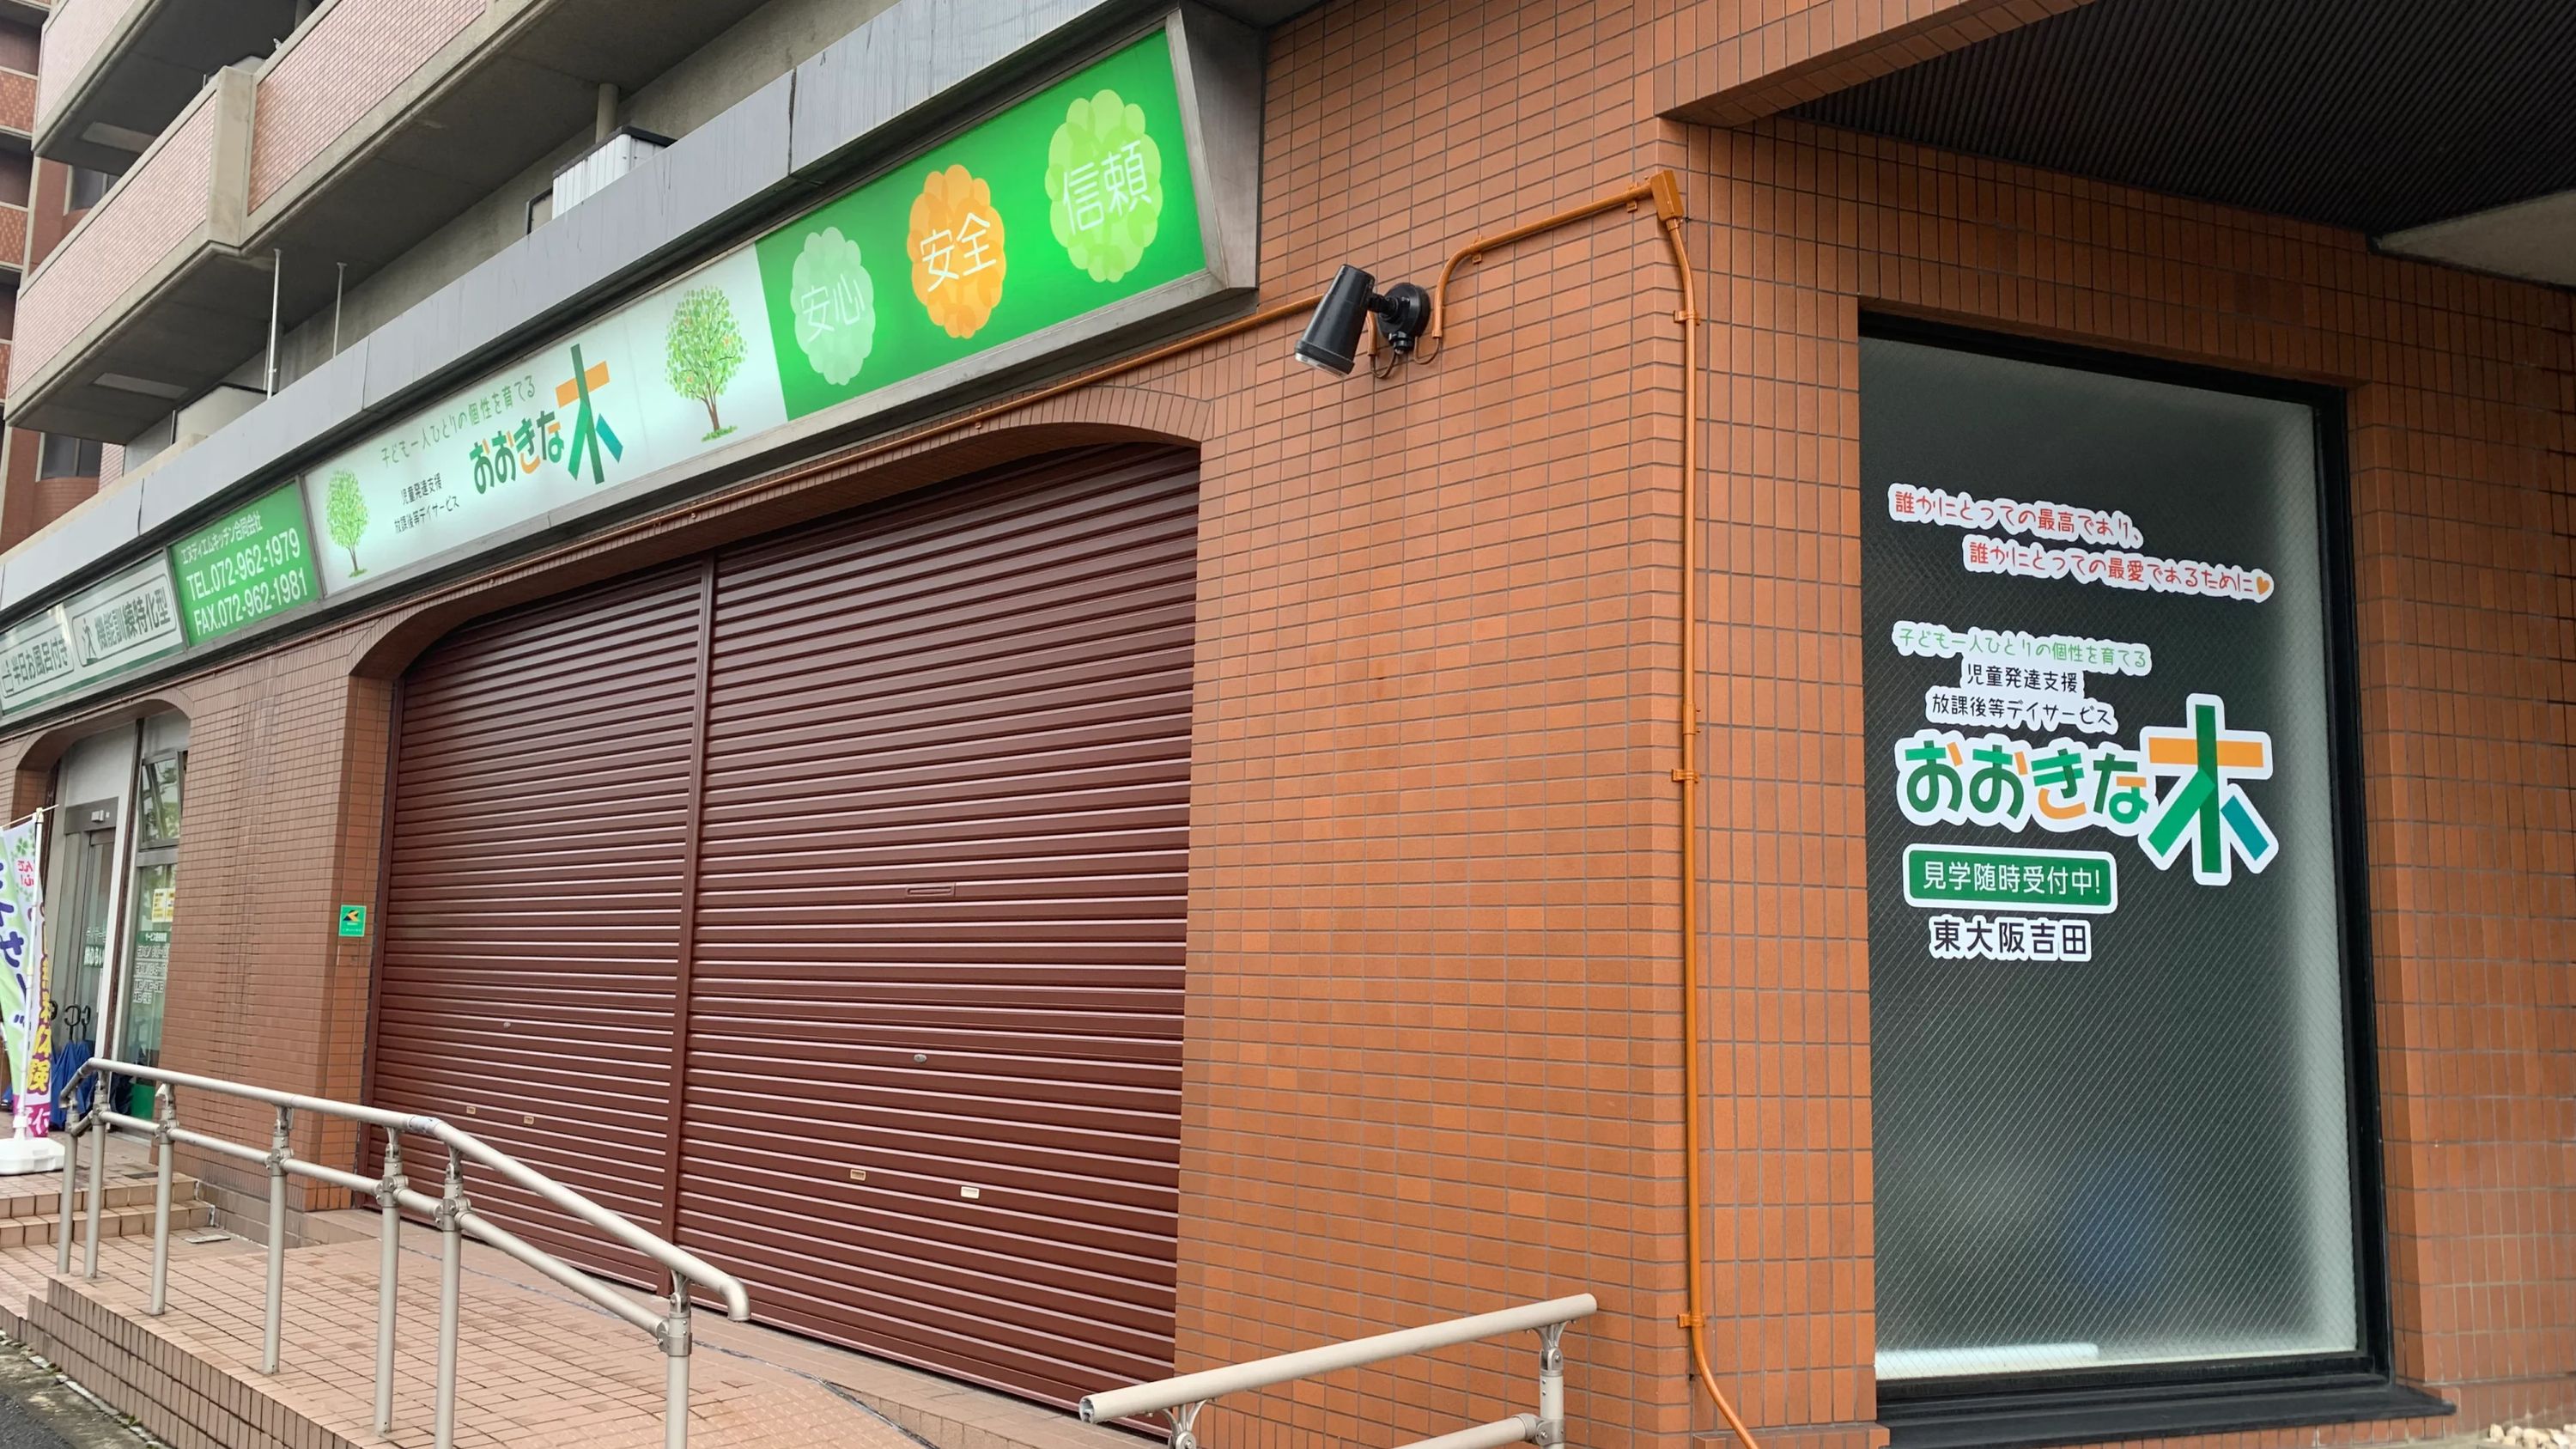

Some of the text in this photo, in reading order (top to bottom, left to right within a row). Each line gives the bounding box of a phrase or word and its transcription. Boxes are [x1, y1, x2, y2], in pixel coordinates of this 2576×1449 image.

[1063, 139, 1152, 234] 信頼
[920, 212, 996, 292] 安全
[800, 273, 866, 342] 安心
[381, 375, 535, 467] 子ども一人ひとりの個性を育てる
[470, 344, 623, 494] おおきな木
[394, 496, 460, 533] 放課後等デイサービス
[401, 472, 443, 505] 児童発達支援
[1894, 490, 2140, 542] 誰かにとっての最高であり、
[186, 527, 301, 600] TEL.072-962-1979
[1969, 541, 2254, 594] 誰かにとっての最愛であるために
[94, 587, 171, 650] 機能訓練特化型
[193, 567, 307, 636] FAX.072-962-1981
[12, 634, 69, 685] 半日お風呂付き
[1899, 627, 2147, 668] 子ども一人ひとりの個性を育てる
[1967, 664, 2078, 694] 児童発達支援
[1932, 694, 2111, 727] 放課後等デイサービス
[1905, 704, 2269, 874] おおきな木
[1923, 861, 2101, 896] 見学随時受付中!
[1933, 920, 2087, 956] 東大阪吉田
